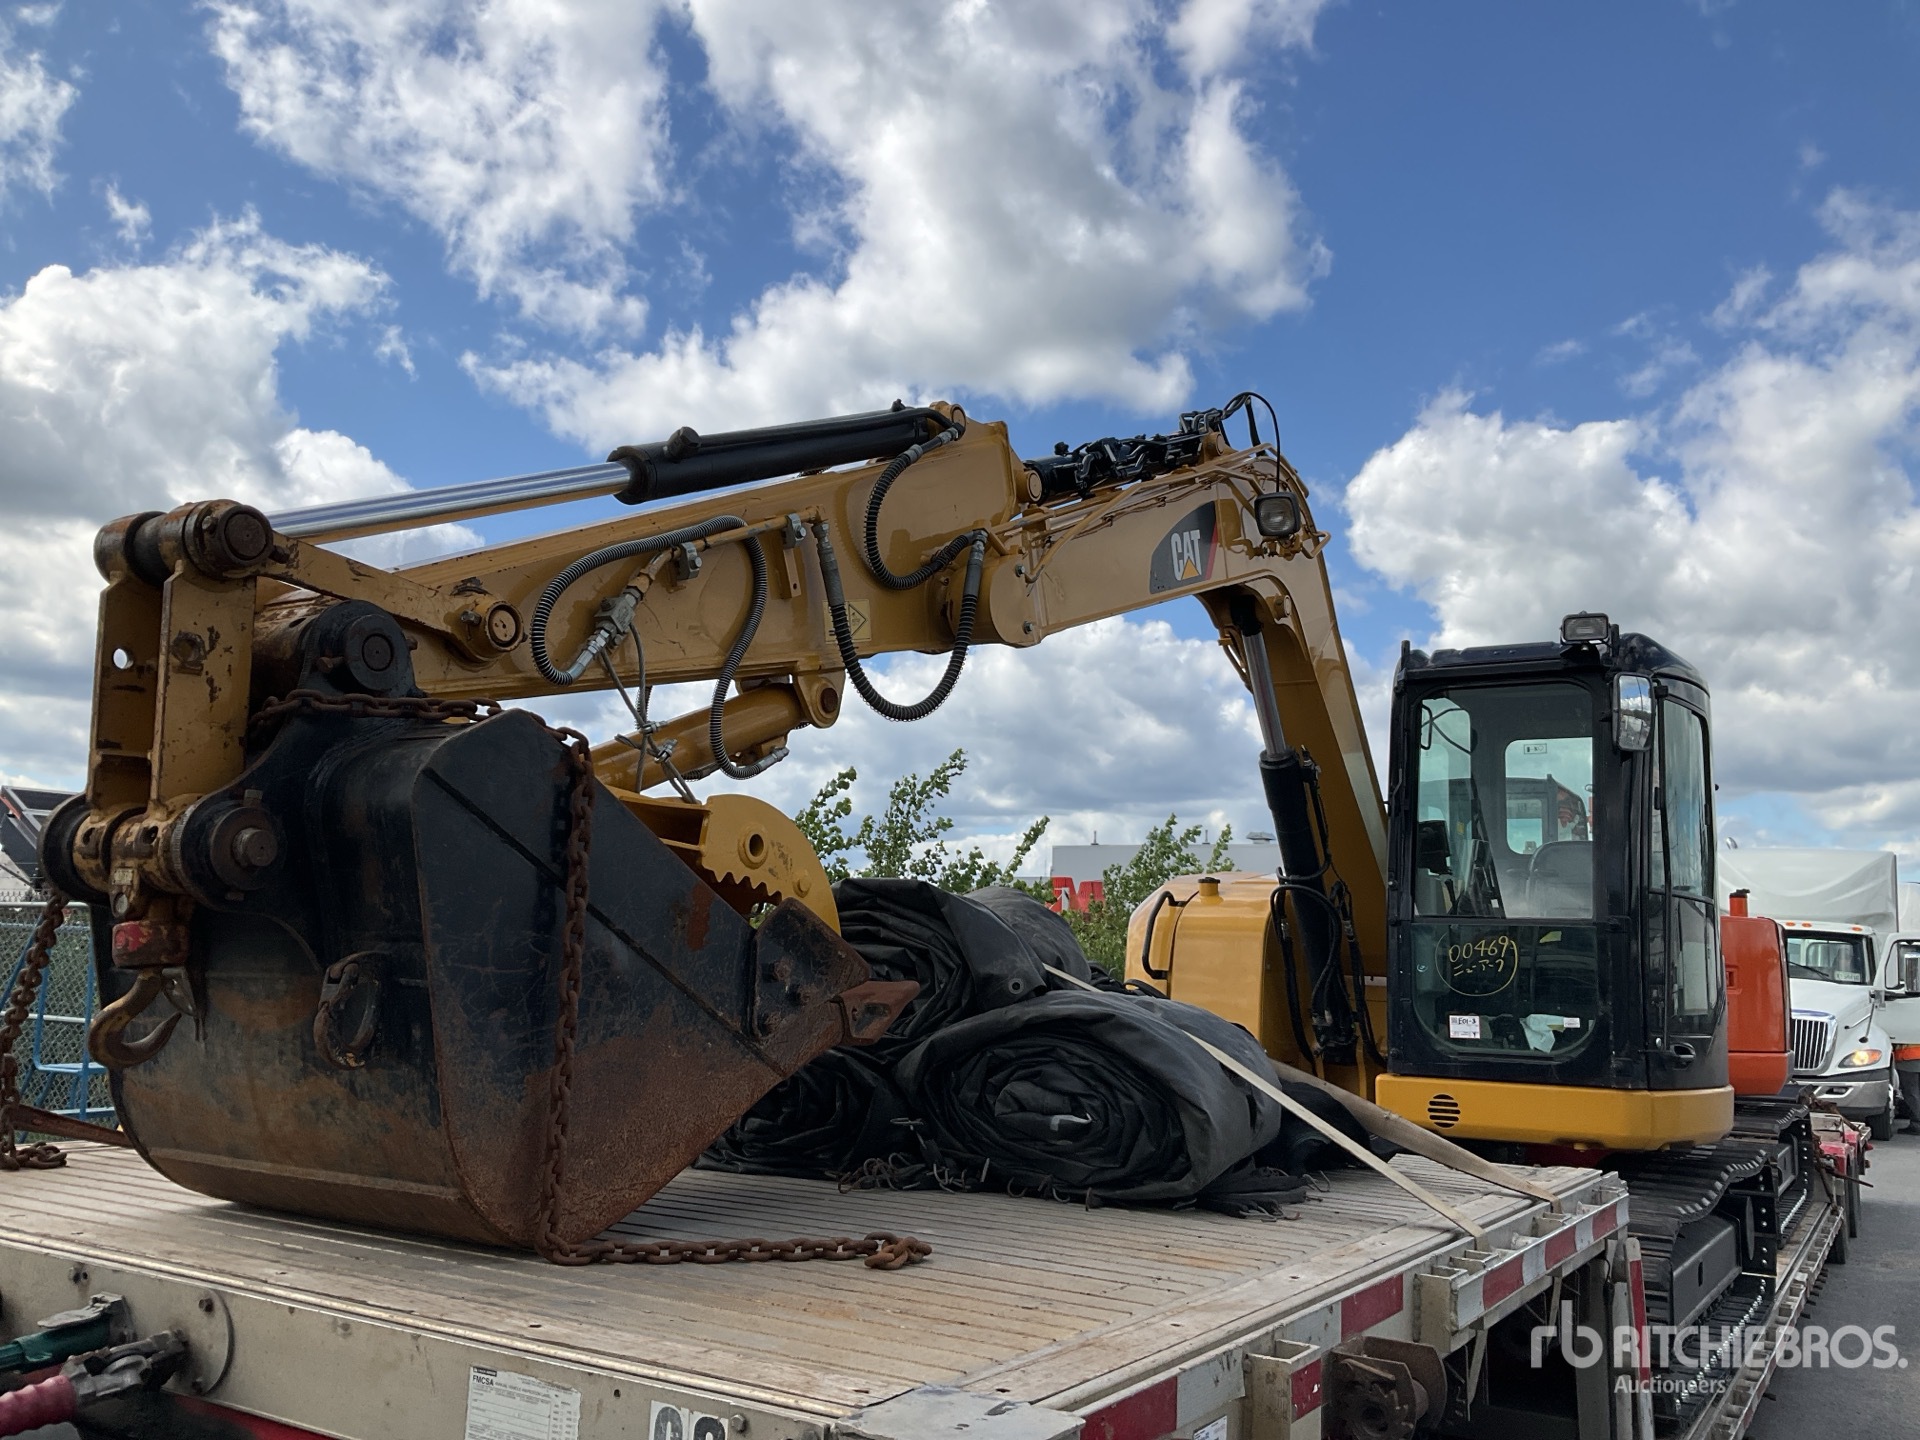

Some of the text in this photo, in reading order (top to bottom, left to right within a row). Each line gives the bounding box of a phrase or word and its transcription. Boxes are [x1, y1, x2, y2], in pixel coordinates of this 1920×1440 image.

[1170, 529, 1202, 581] CAT
[1449, 936, 1508, 962] 00469
[472, 1374, 495, 1387] FMCSA
